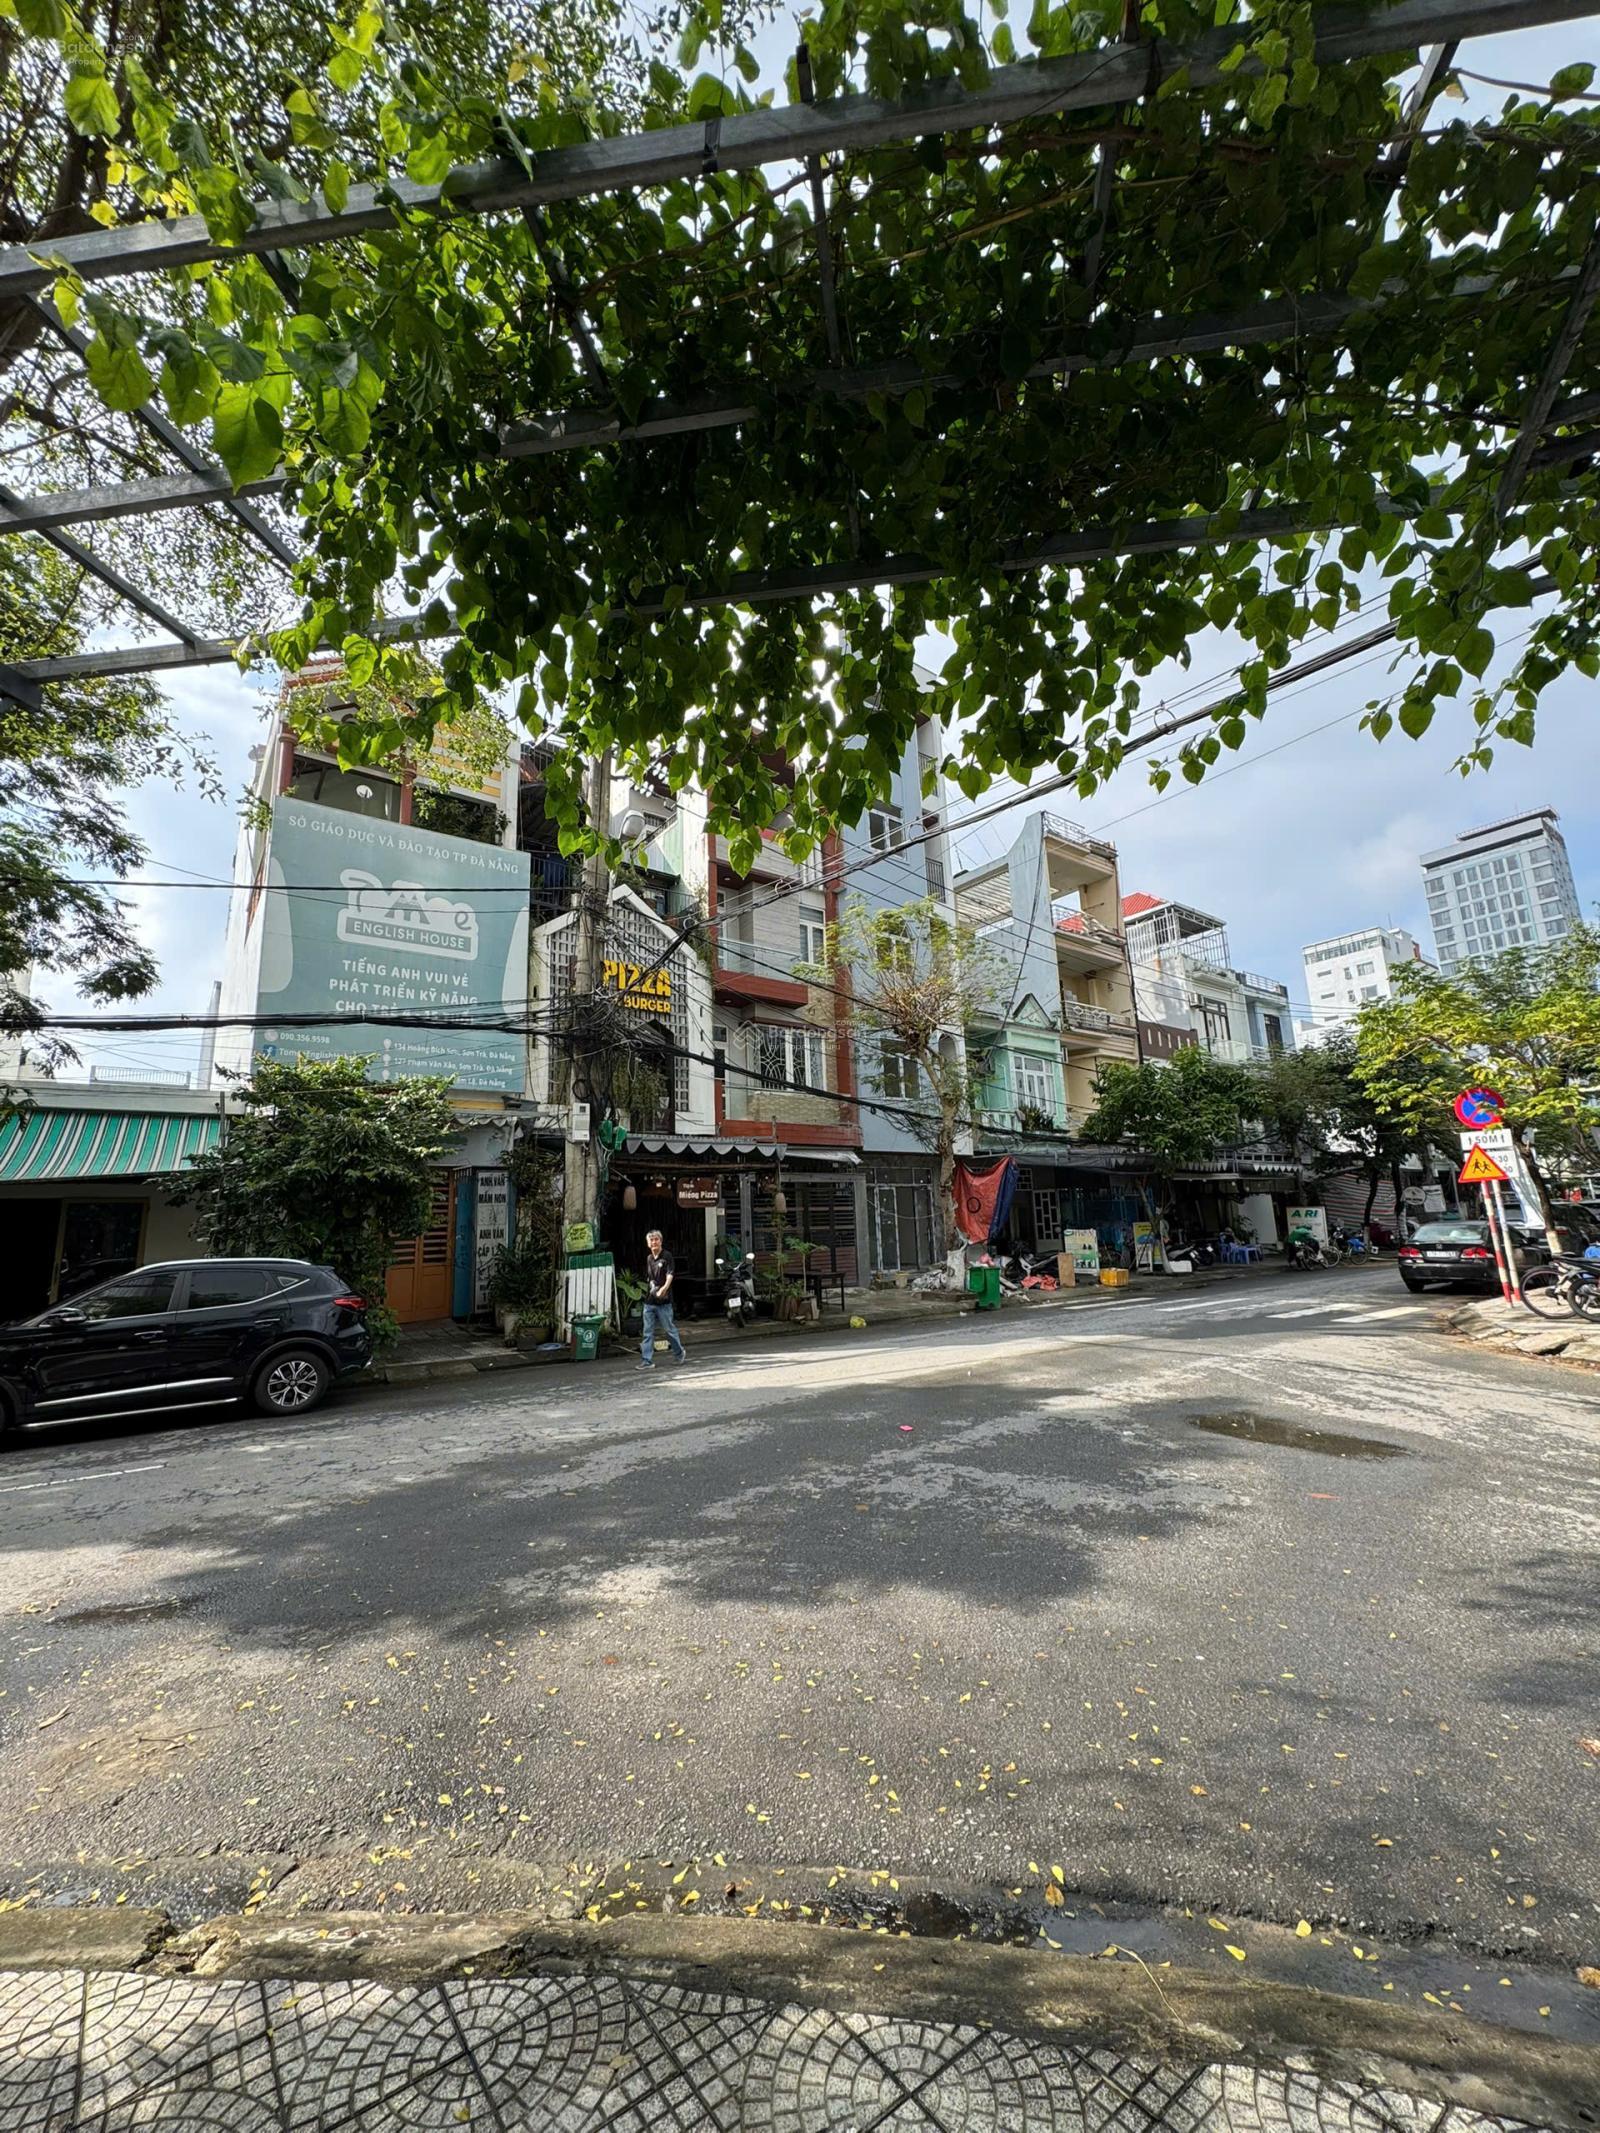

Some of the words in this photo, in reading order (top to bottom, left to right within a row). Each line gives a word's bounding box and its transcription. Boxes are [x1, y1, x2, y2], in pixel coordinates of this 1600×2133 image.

[311, 820, 344, 838] GIÁO
[378, 834, 394, 849] VÀ
[399, 838, 424, 855] ĐÀO
[425, 845, 451, 861] TẠO
[452, 851, 468, 863] TP
[470, 854, 486, 868] ĐÀ
[353, 920, 415, 942] ENGLISH
[420, 930, 465, 949] HOUSE
[342, 957, 387, 976] TIẾNG
[391, 966, 420, 981] ANH
[425, 971, 449, 985] VUI
[452, 973, 470, 988] VẺ
[603, 959, 672, 997] PIZZA
[329, 978, 369, 994] PHÁT
[373, 981, 415, 1000] TRIỂN
[419, 987, 437, 1002] KỸ
[441, 991, 478, 1006] NĂNG
[624, 996, 672, 1014] BURGER
[1475, 1134, 1498, 1144] 50M
[700, 1190, 718, 1199] Pizza
[480, 1228, 492, 1240] ANH
